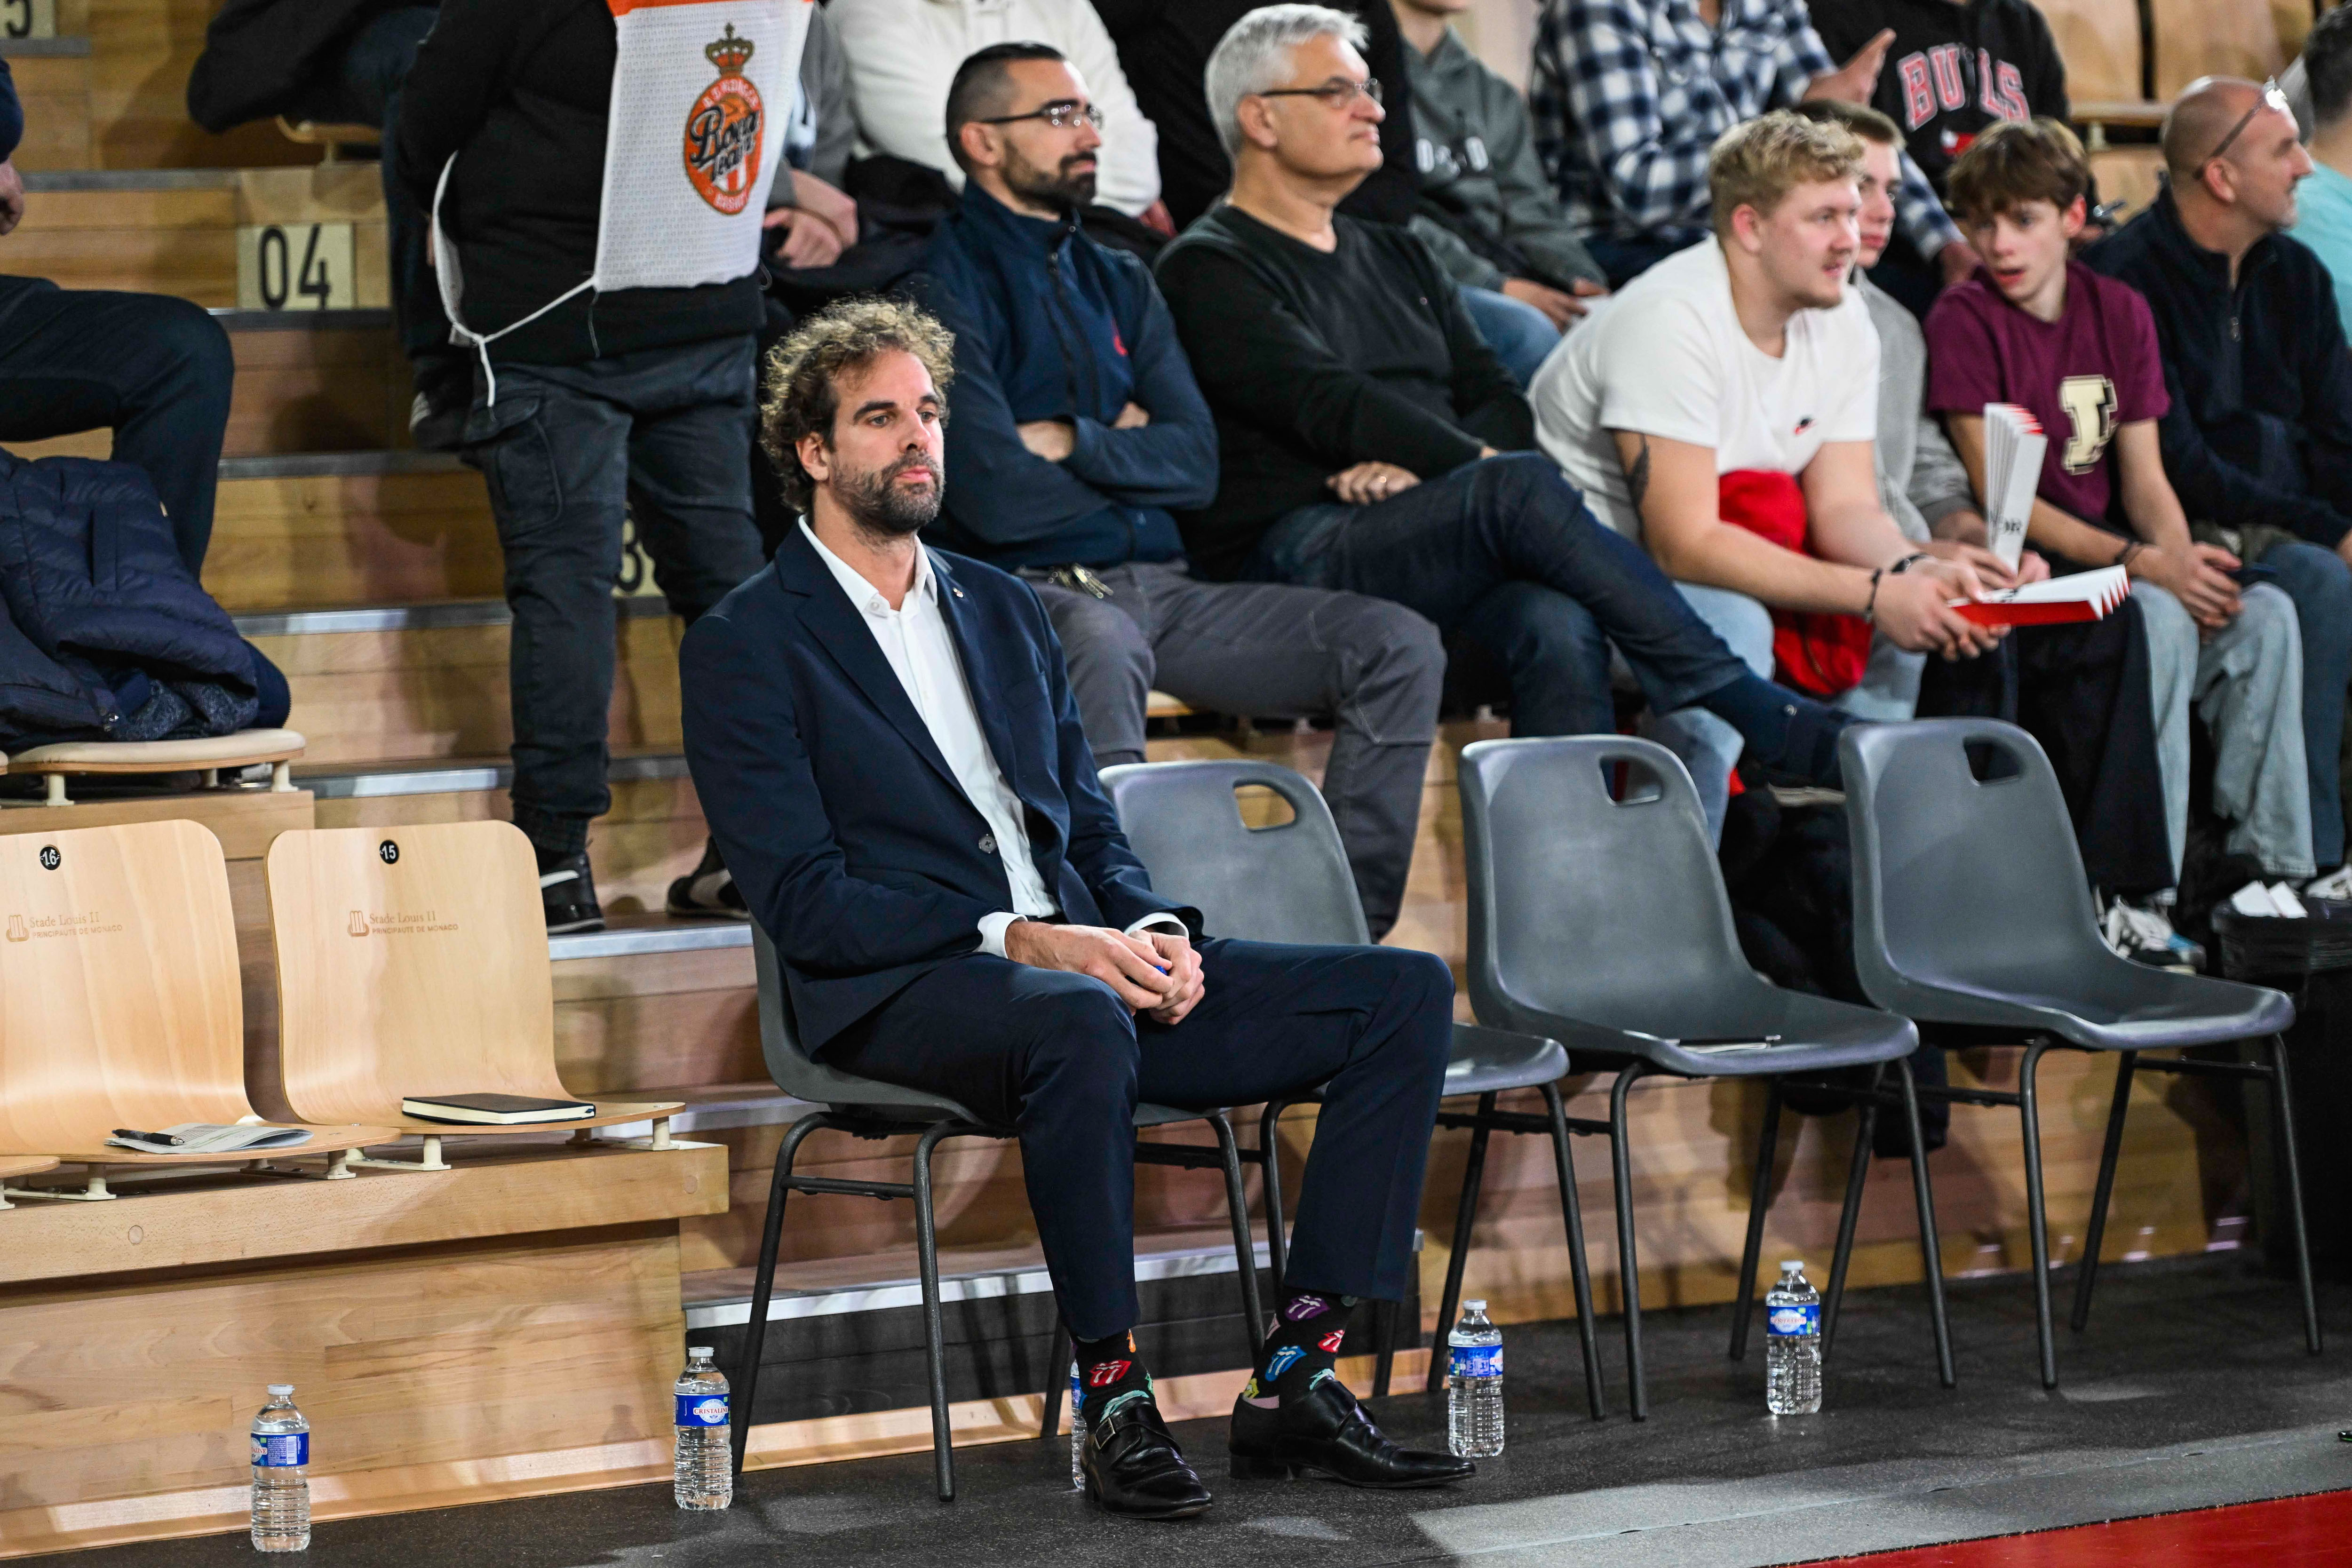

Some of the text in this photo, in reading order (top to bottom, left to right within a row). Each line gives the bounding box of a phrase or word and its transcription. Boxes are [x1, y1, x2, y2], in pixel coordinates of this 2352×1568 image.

[1897, 42, 2031, 133] BULS
[258, 222, 331, 310] 04
[42, 851, 56, 866] 16
[381, 844, 396, 860] 15
[30, 911, 100, 928] Stade Louis II
[369, 910, 436, 924] Stade Louis II
[91, 924, 122, 933] MONACO
[428, 923, 459, 932] MONACO
